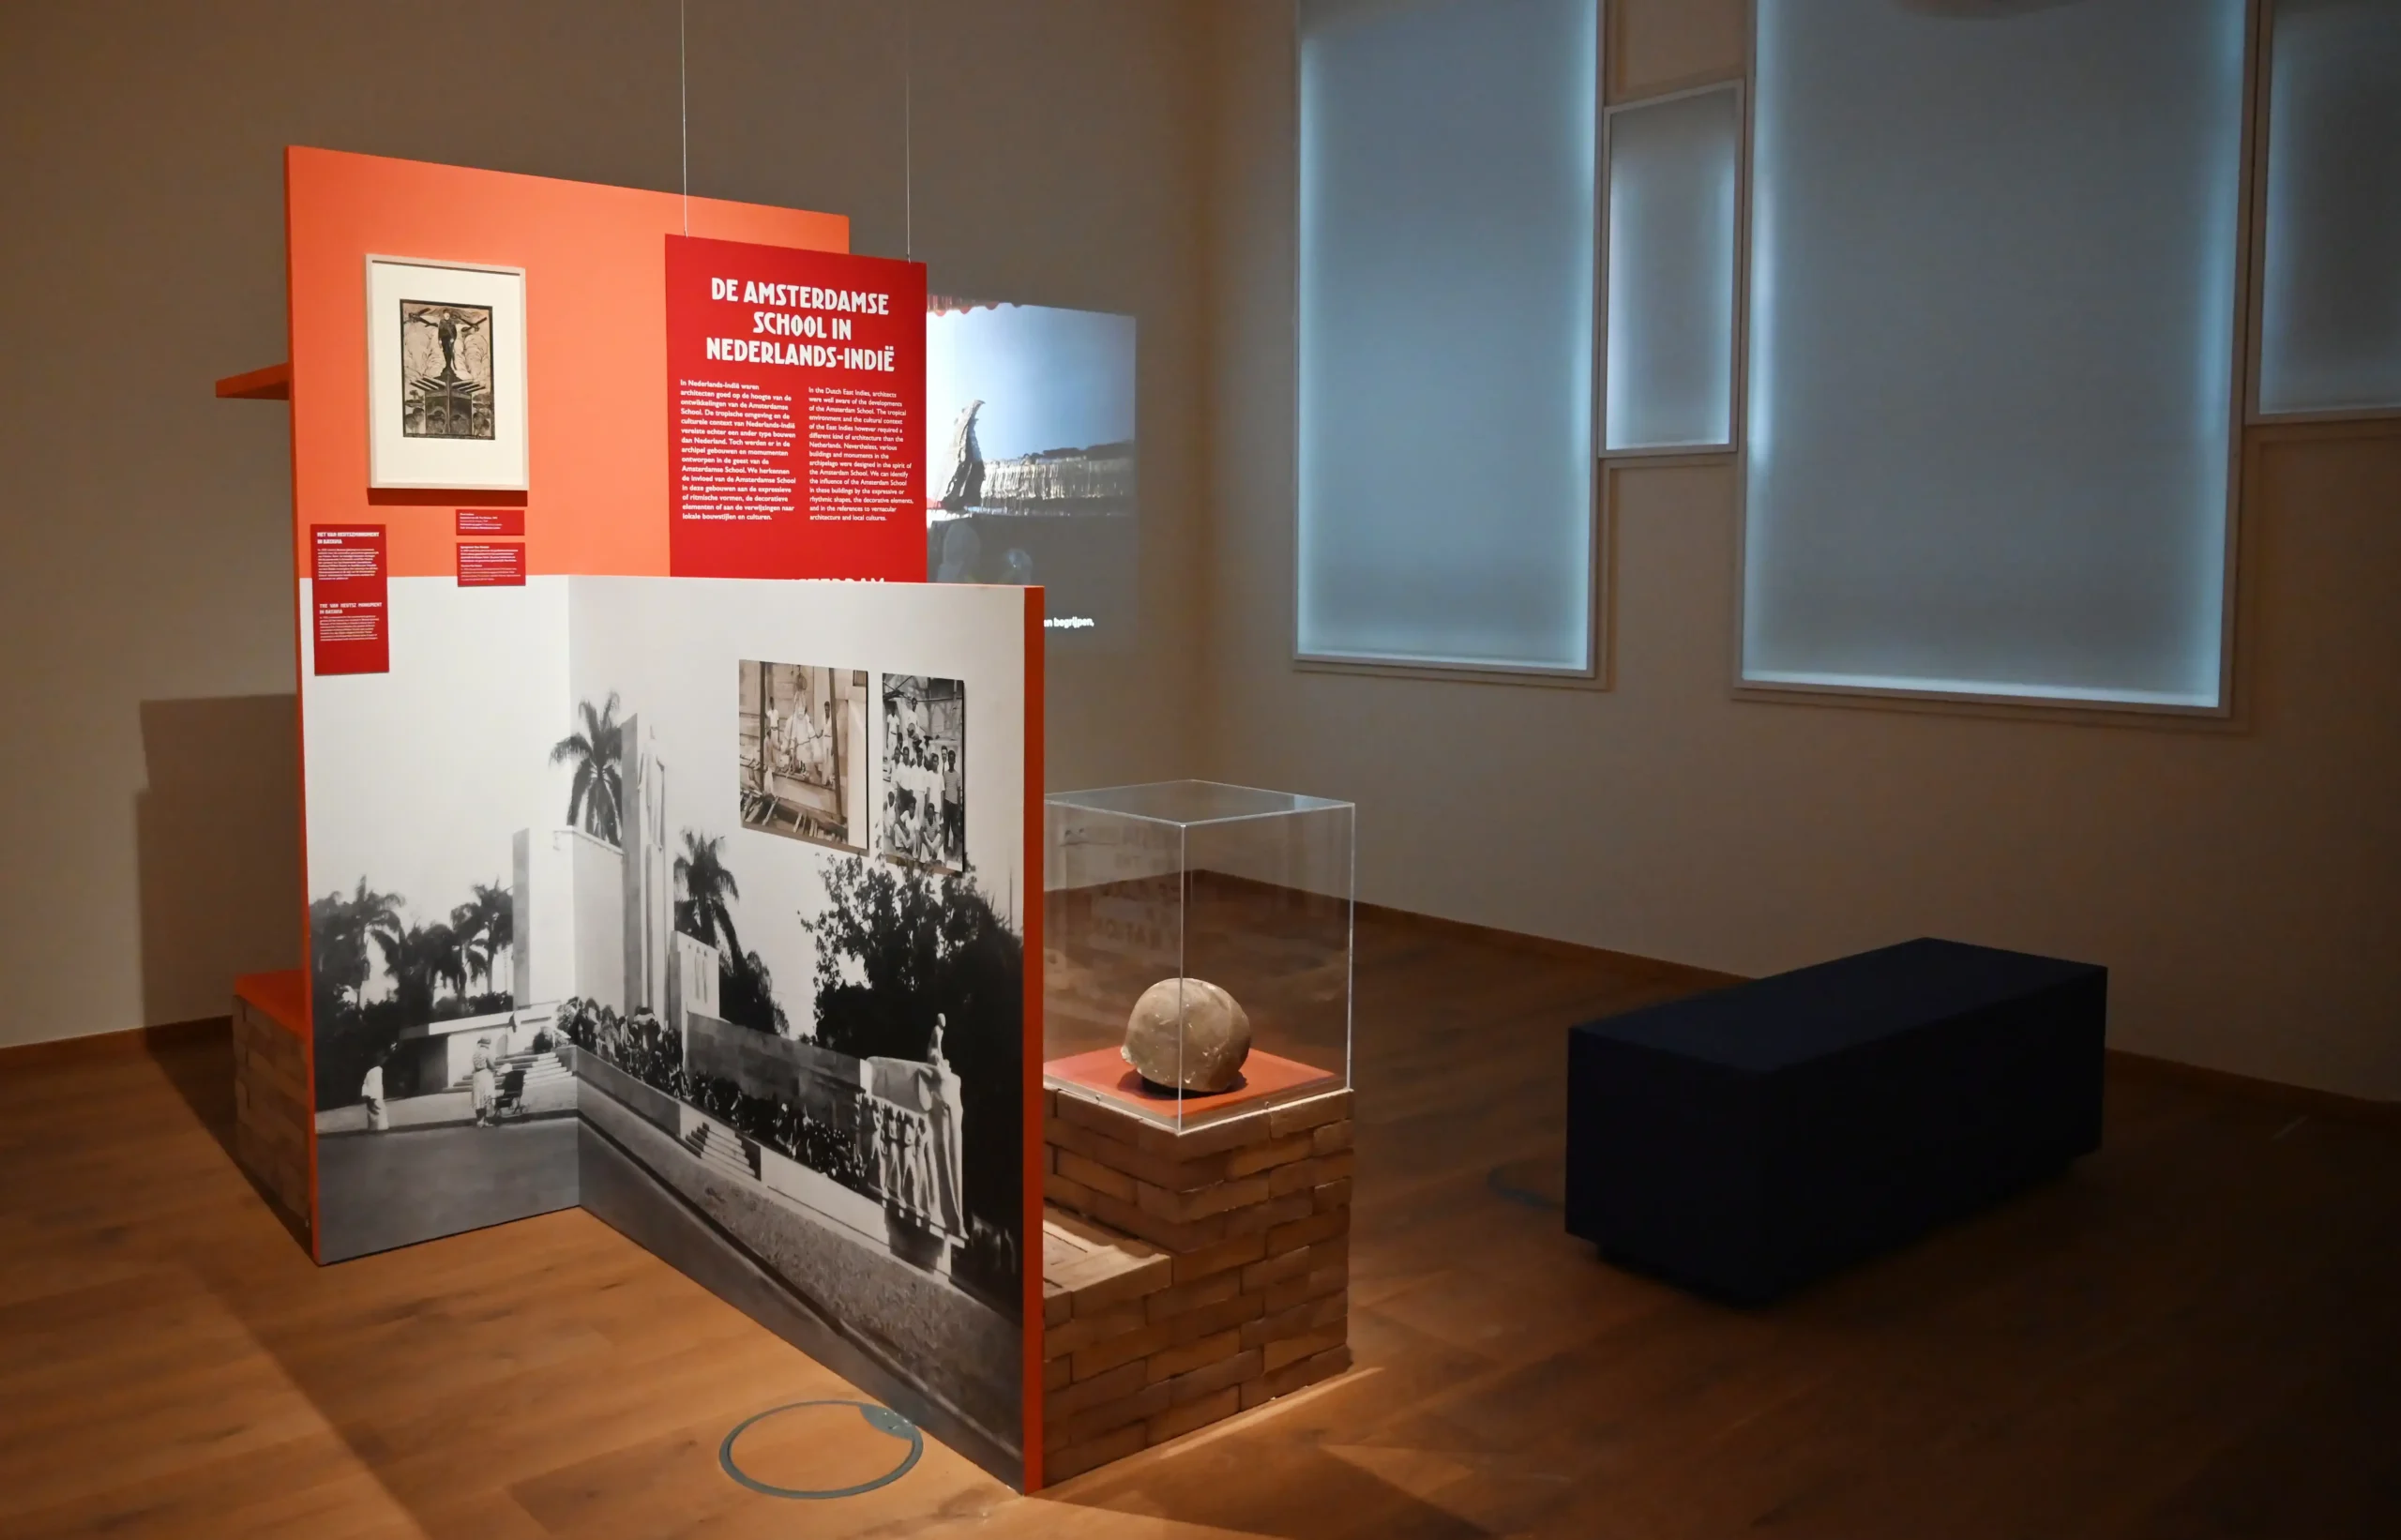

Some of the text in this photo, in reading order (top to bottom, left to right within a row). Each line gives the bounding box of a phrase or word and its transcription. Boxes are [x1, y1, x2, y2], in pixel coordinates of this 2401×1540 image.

[711, 278, 889, 315] DE AMSTERDAMSE
[752, 311, 852, 340] SCHOOL IN
[706, 337, 895, 372] NEDERLANDS-INDIË
[681, 389, 715, 398] architecten
[716, 391, 732, 400] goed
[750, 393, 771, 402] hoogte
[748, 402, 788, 411] Amsterdamse
[868, 400, 902, 409] developments
[716, 410, 743, 419] tropische
[745, 411, 773, 421] omgeving
[887, 409, 906, 417] tropical
[808, 414, 841, 422] environment
[877, 427, 898, 435] required
[682, 446, 706, 455] archipel
[706, 447, 737, 457] gebouwen
[809, 450, 832, 460] buildings
[682, 457, 716, 465] ontworpen
[732, 458, 748, 466] geest
[705, 485, 736, 493] gebouwen
[758, 486, 792, 494] expressieve
[702, 513, 736, 521] bouwstijlen
